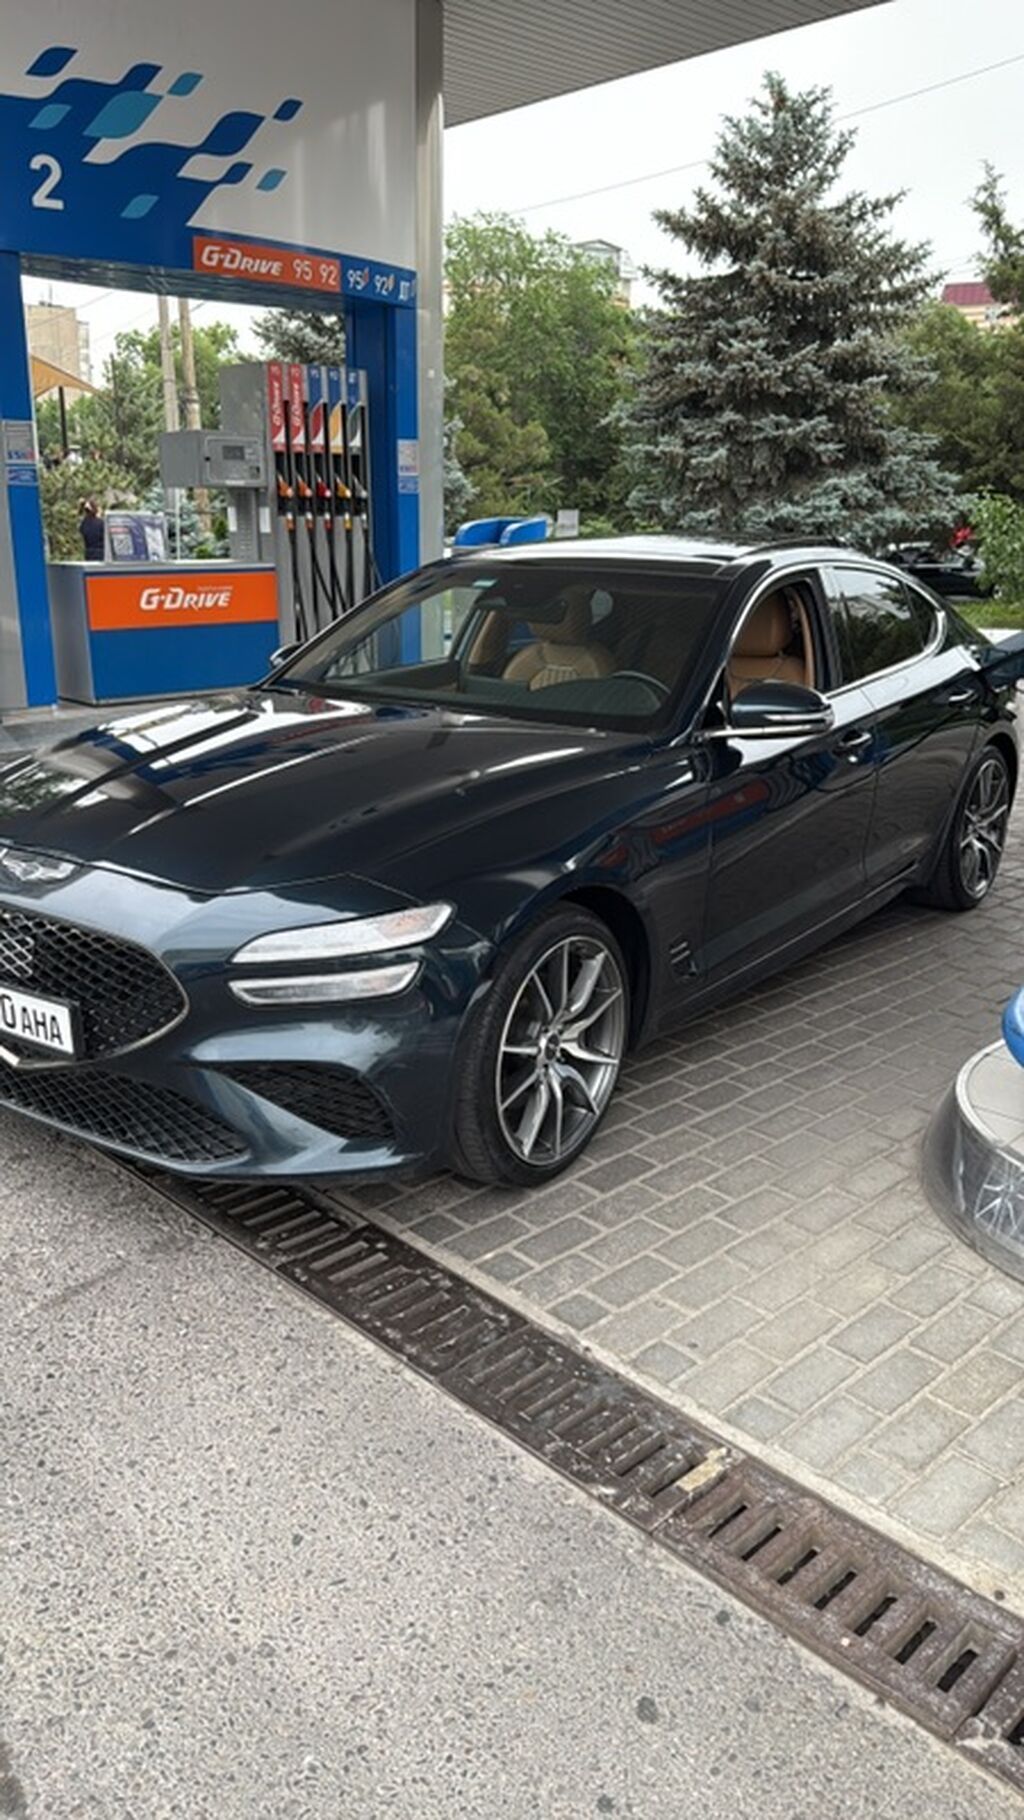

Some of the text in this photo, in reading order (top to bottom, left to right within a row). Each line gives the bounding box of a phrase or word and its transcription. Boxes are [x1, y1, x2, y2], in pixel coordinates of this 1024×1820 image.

[30, 153, 64, 210] 2
[292, 259, 313, 281] 95
[319, 264, 338, 286] 92
[347, 269, 363, 291] 95
[374, 274, 388, 296] 92
